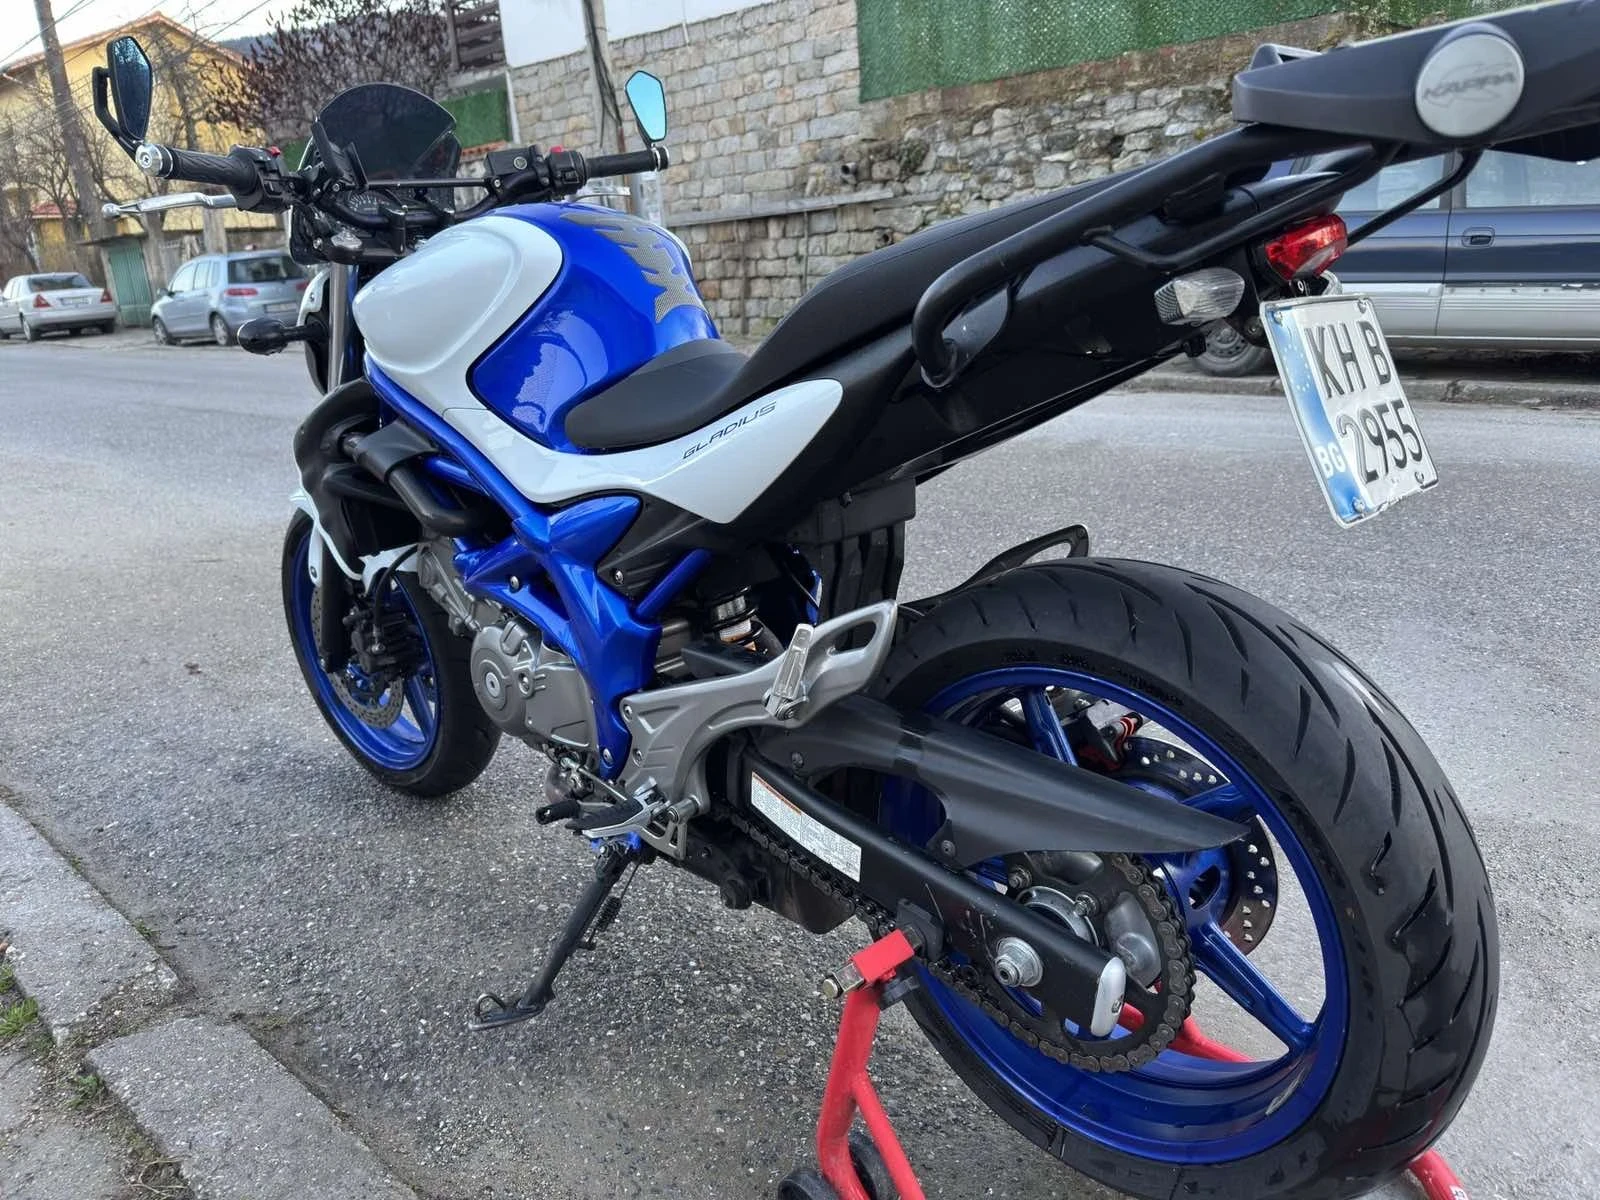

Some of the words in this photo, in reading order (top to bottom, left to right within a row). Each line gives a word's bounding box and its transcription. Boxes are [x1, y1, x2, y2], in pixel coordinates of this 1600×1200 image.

[683, 401, 777, 459] GLADIUS
[1336, 401, 1422, 483] 2955
[1314, 442, 1346, 477] BG
